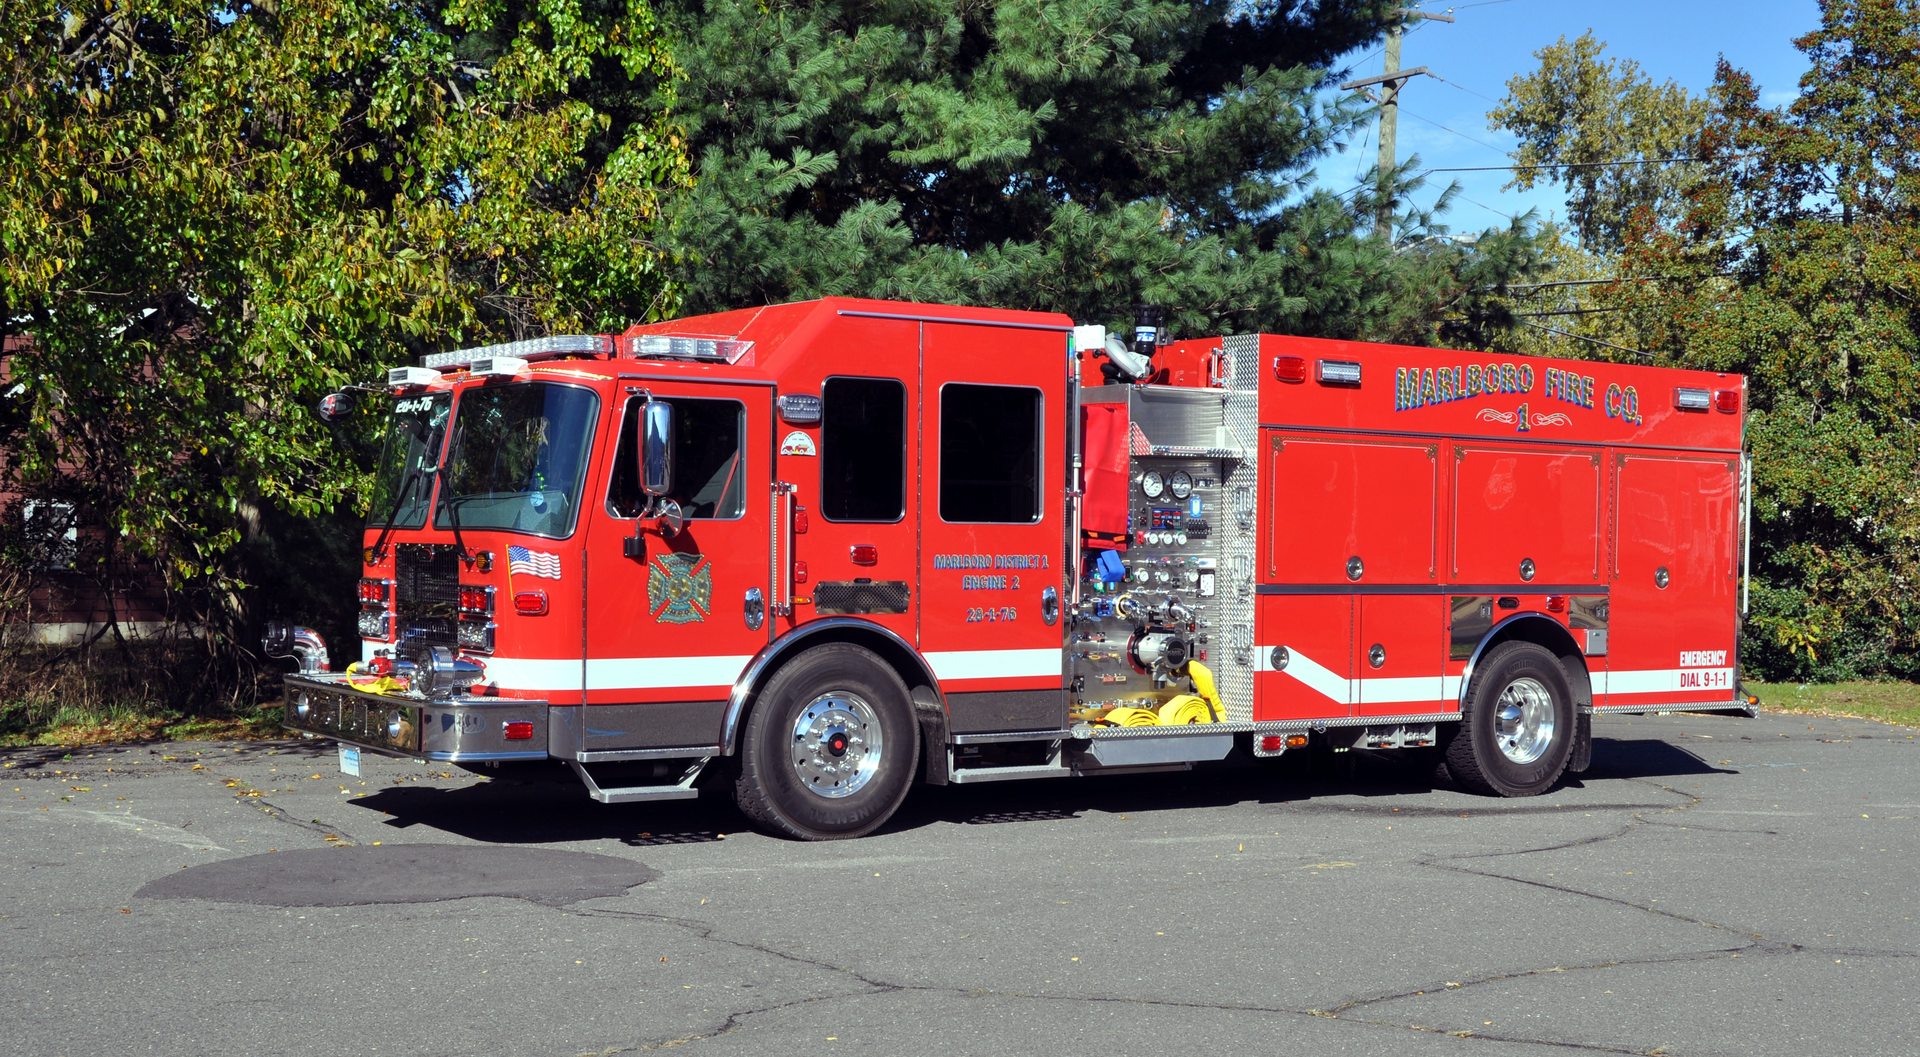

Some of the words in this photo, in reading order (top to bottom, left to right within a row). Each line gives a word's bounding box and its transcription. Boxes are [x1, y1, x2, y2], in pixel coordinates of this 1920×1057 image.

[1395, 363, 1534, 412] MARLBORO
[1546, 367, 1594, 409] FIRE
[1604, 383, 1642, 426] CO.
[1516, 403, 1531, 432] 1
[934, 554, 992, 570] MARLBORO
[994, 554, 1040, 570] DISTRICT
[1041, 555, 1049, 570] 1
[962, 575, 1007, 590] ENGINE
[1011, 575, 1020, 590] 2
[966, 607, 1018, 622] 28-1-76
[1680, 650, 1727, 667] EMERGENCY
[1680, 672, 1701, 687] DIAL
[1704, 671, 1727, 687] 9-1-1
